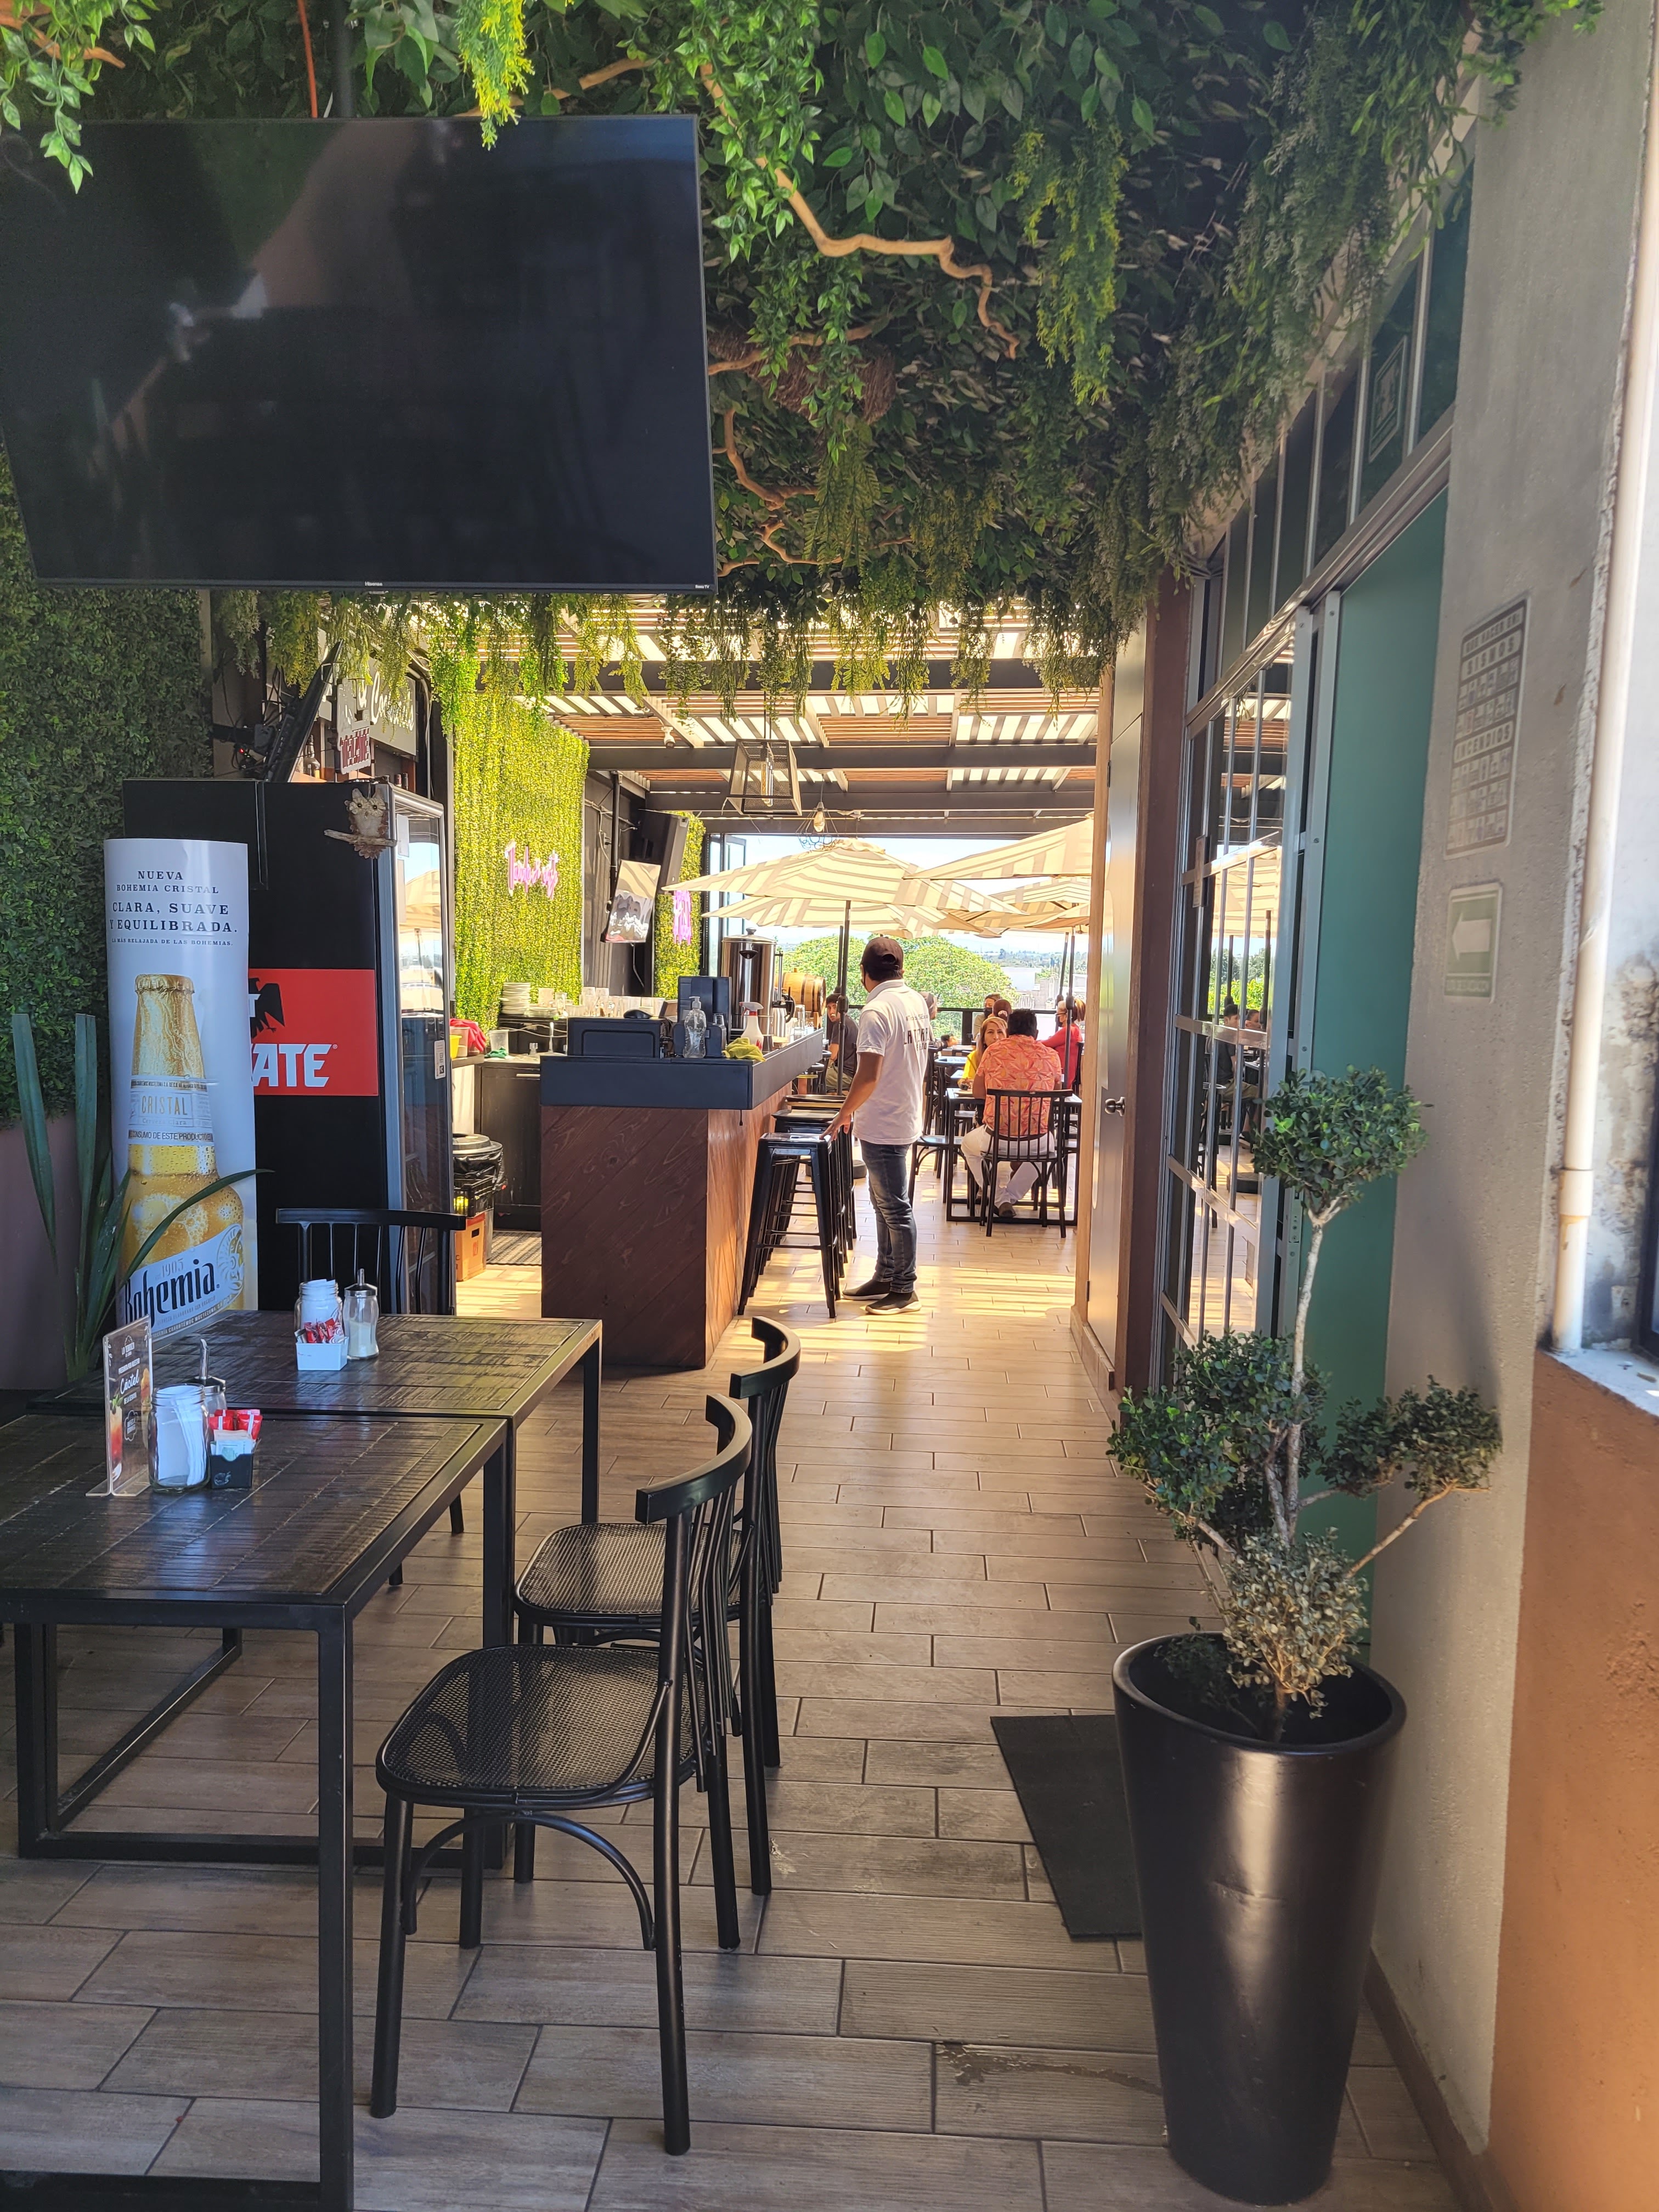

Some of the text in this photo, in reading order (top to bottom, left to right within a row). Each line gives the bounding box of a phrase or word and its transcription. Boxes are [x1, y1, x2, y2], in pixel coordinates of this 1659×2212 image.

[1467, 635, 1515, 675] SISMOS
[1456, 724, 1510, 758] INCENDIOS
[138, 871, 183, 880] NUEVA
[116, 884, 219, 894] BOHEMIA CRISTAL
[112, 902, 229, 915] CLARA, SUAVE
[110, 919, 238, 933] Y EQUILIBRADA.
[251, 1043, 332, 1087] ATE
[142, 1096, 188, 1115] CRISTAL
[125, 1259, 215, 1328] Bohemia
